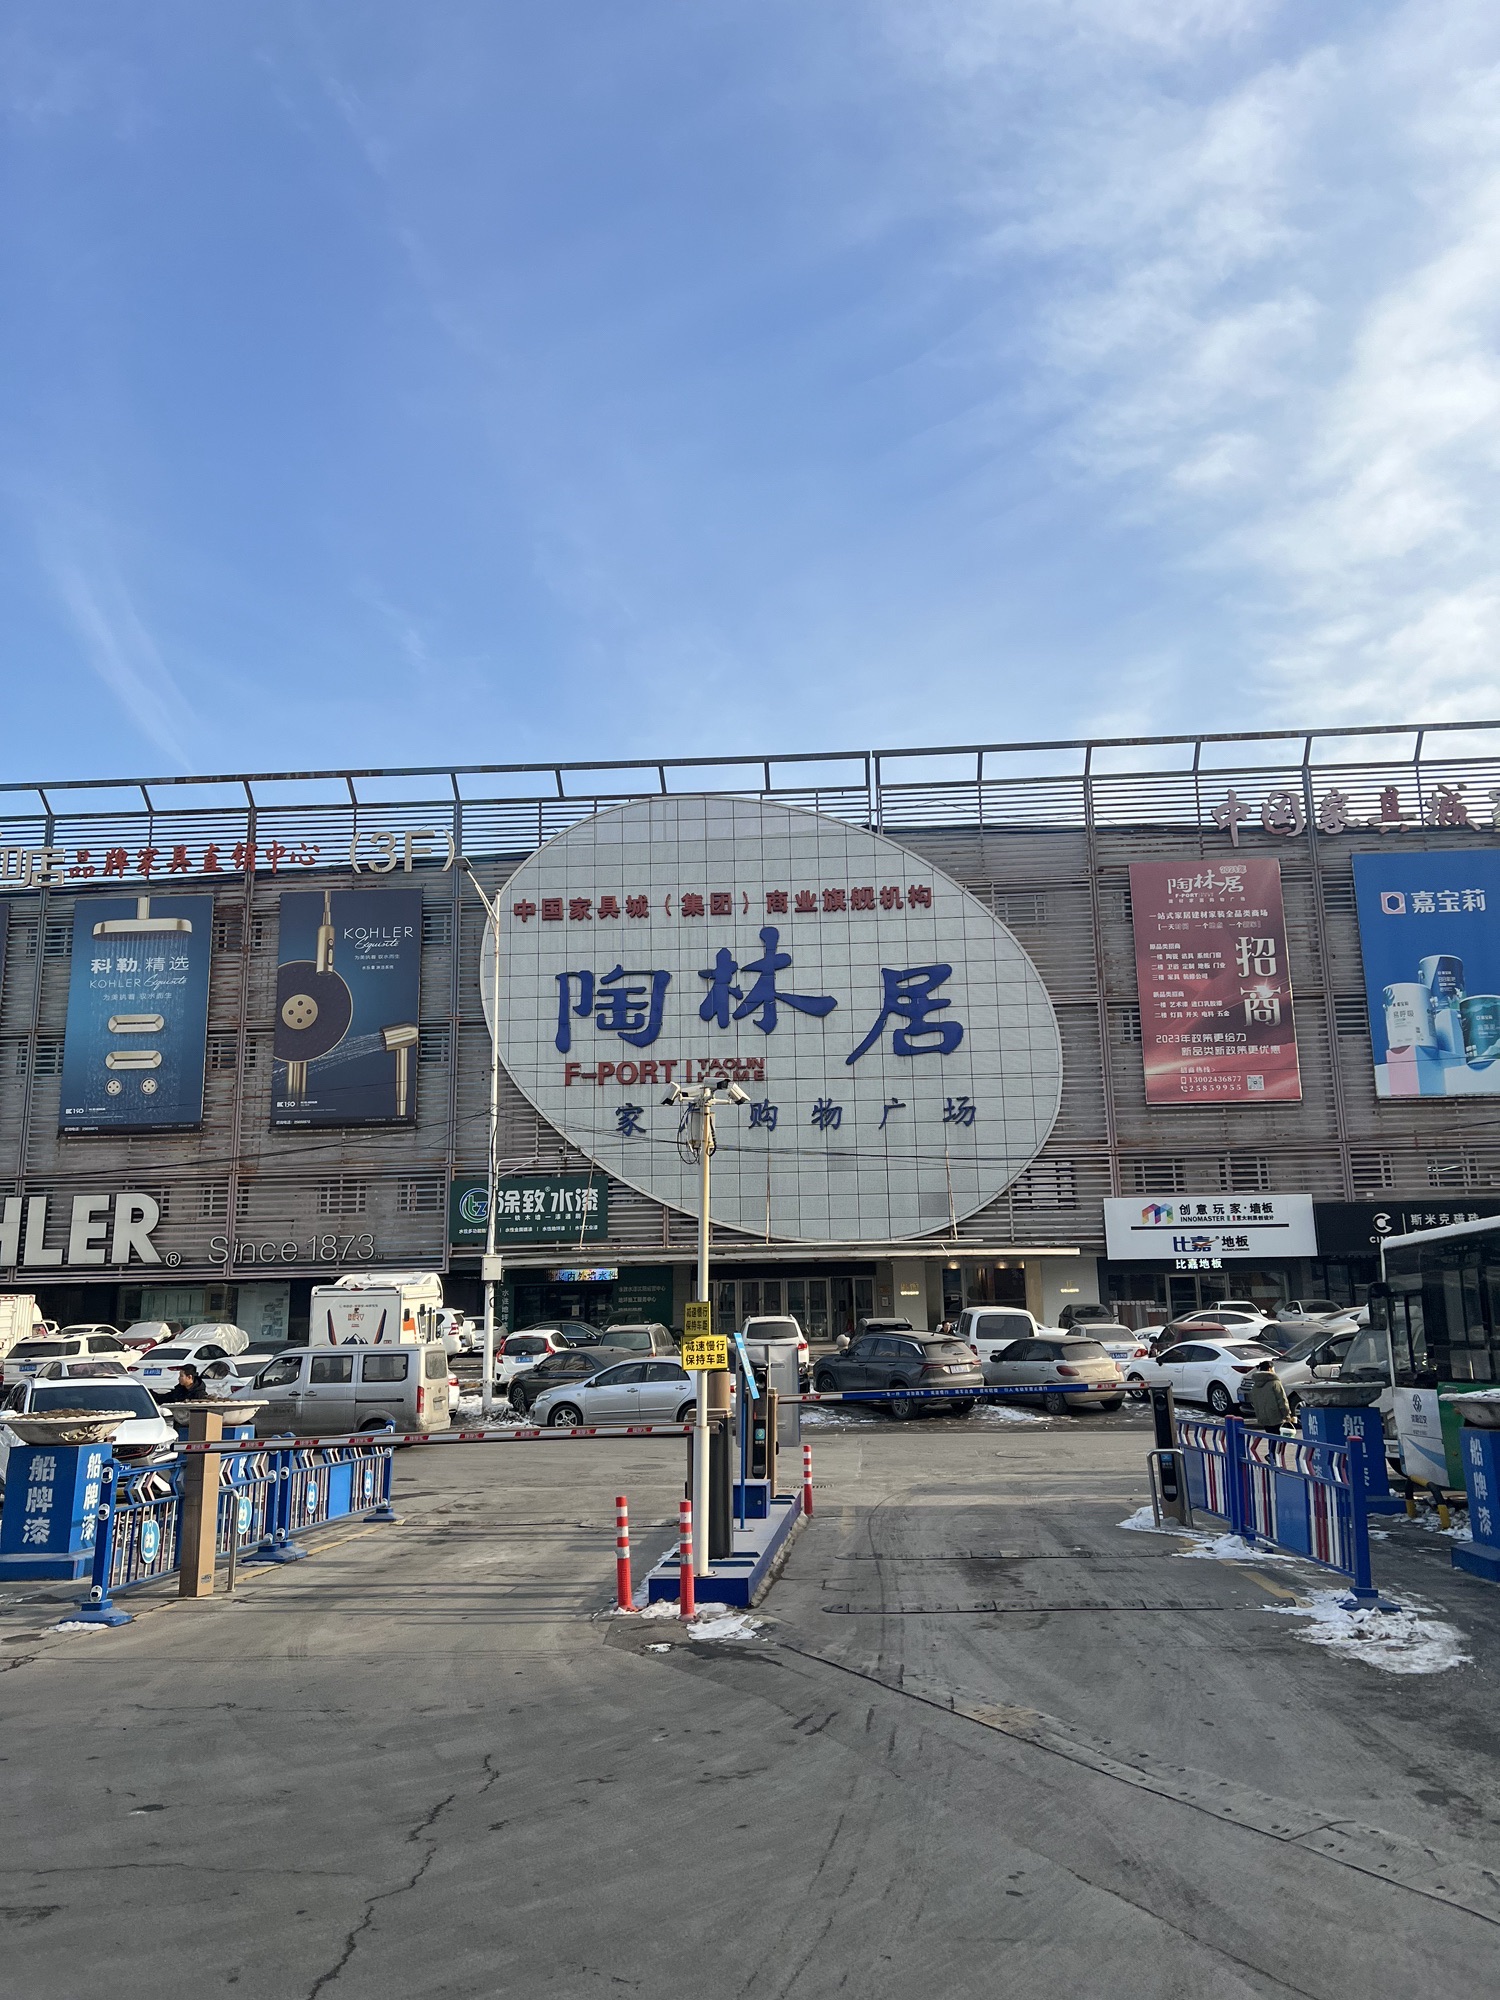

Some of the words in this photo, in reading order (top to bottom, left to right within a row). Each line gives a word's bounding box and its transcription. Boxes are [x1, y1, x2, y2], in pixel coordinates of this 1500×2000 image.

[350, 829, 455, 876] (3F)
[68, 840, 320, 880] 品牌家具直销中心
[1167, 869, 1245, 895] 陶林居
[1411, 888, 1487, 914] 嘉宝莉
[1149, 910, 1268, 919] 一站式家居建材家装全品类商场
[344, 926, 414, 939] KOHLER
[90, 978, 141, 989] KOHLER
[1235, 936, 1281, 1026] 招商
[555, 926, 965, 1066] 陶林居
[1156, 1032, 1247, 1043] 2023年政策更给力
[1181, 1045, 1281, 1056] 新品类新政策更优惠
[697, 1057, 765, 1070] TAOLIN
[565, 1060, 678, 1086] F-PORT
[615, 1096, 976, 1137] 家购物广场
[1180, 1215, 1225, 1223] INNOMASTER
[1410, 1212, 1480, 1226] 斯米克磁砖
[1222, 1235, 1249, 1248] 地板
[208, 1236, 299, 1264] Since
[308, 1233, 375, 1262] 1873
[1175, 1258, 1223, 1270] 比嘉地板
[686, 1320, 708, 1331] 保持车距
[686, 1341, 726, 1352] 减速慢行
[686, 1354, 726, 1365] 保持车距
[1469, 1437, 1493, 1536] 船牌漆
[22, 1454, 57, 1545] 船牌漆
